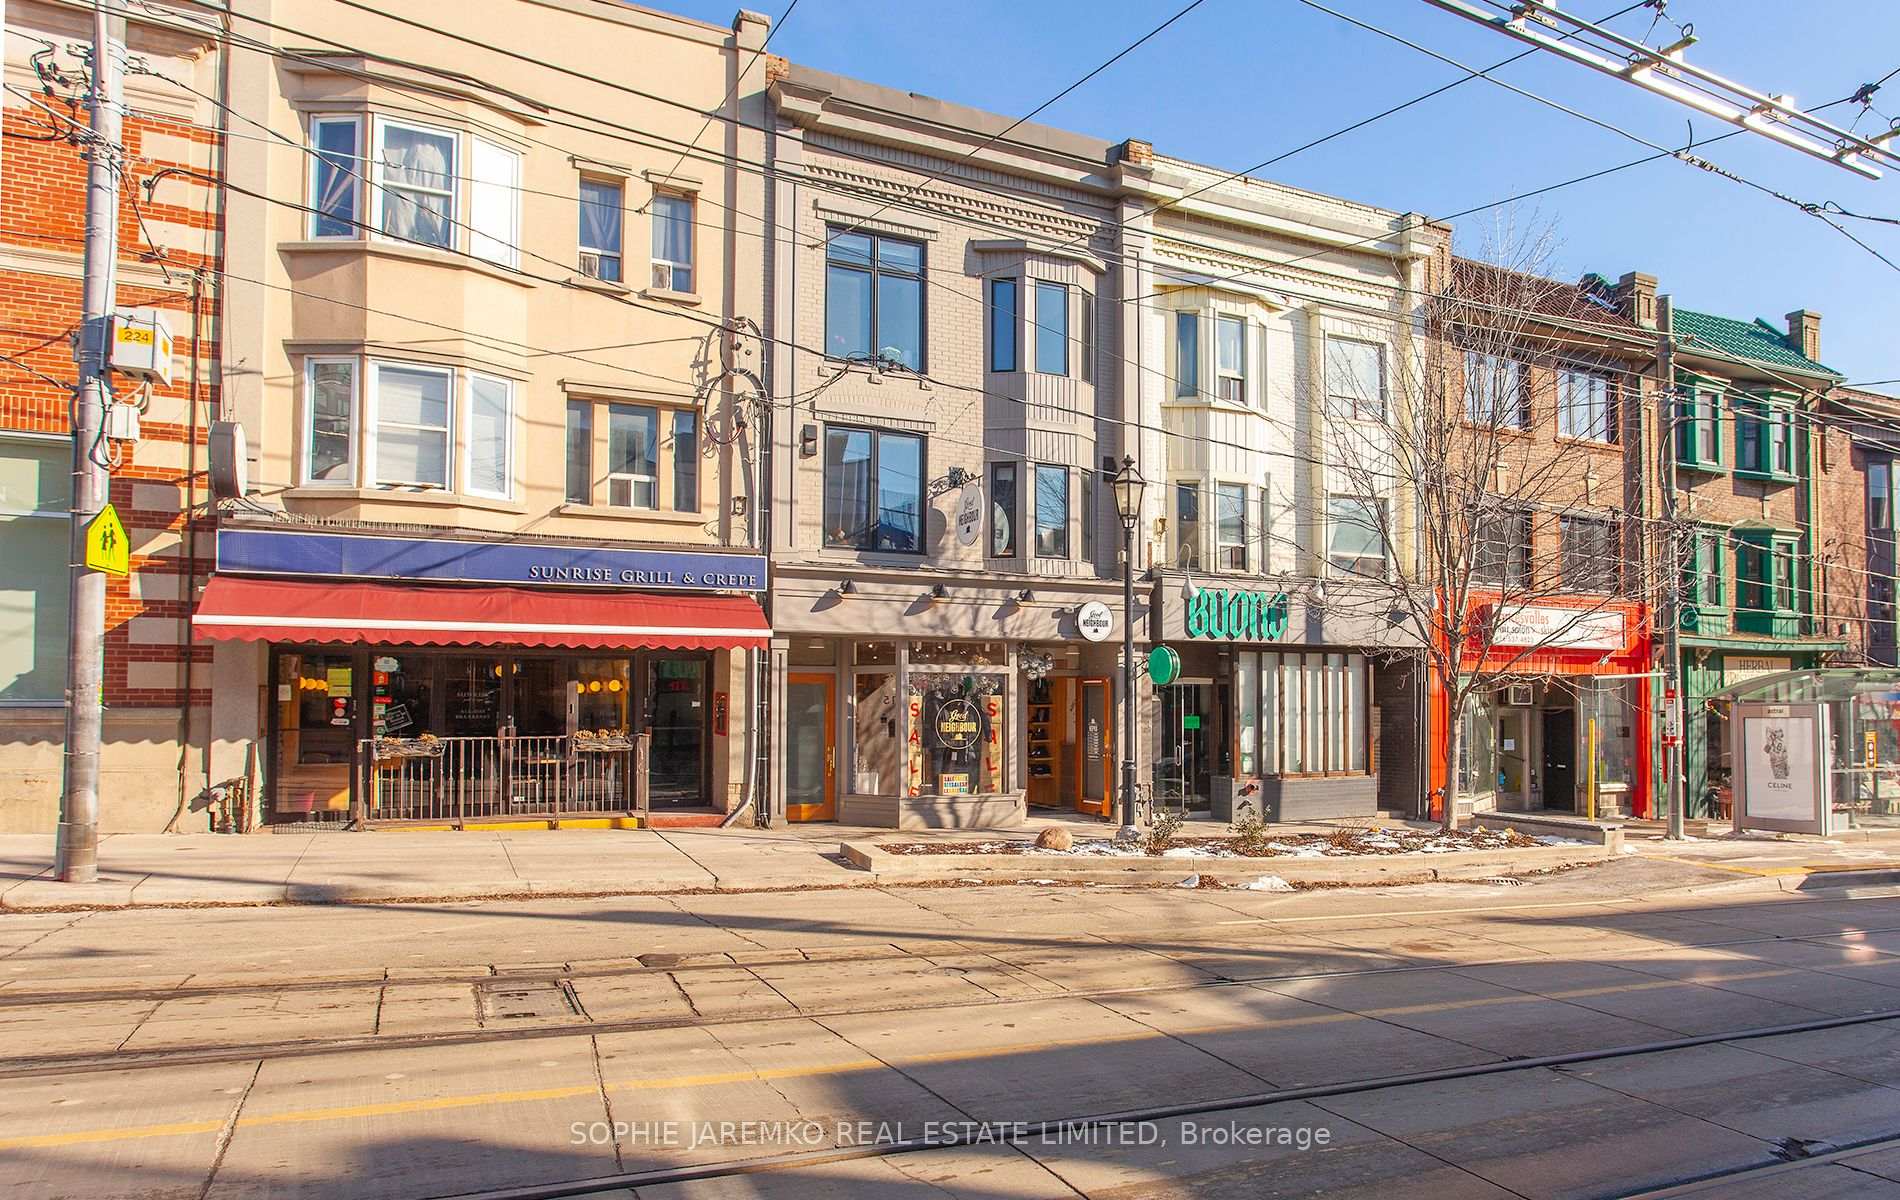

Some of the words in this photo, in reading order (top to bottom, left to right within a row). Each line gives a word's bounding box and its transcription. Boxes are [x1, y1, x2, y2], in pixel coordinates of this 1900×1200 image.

[124, 331, 149, 342] 224
[529, 565, 613, 581] SUNRISE
[620, 568, 675, 584] GRILL
[682, 571, 696, 585] &
[701, 572, 757, 587] CREPE
[949, 709, 968, 722] Good
[940, 721, 977, 733] NEIGHBOUR
[1767, 782, 1793, 790] CELINE
